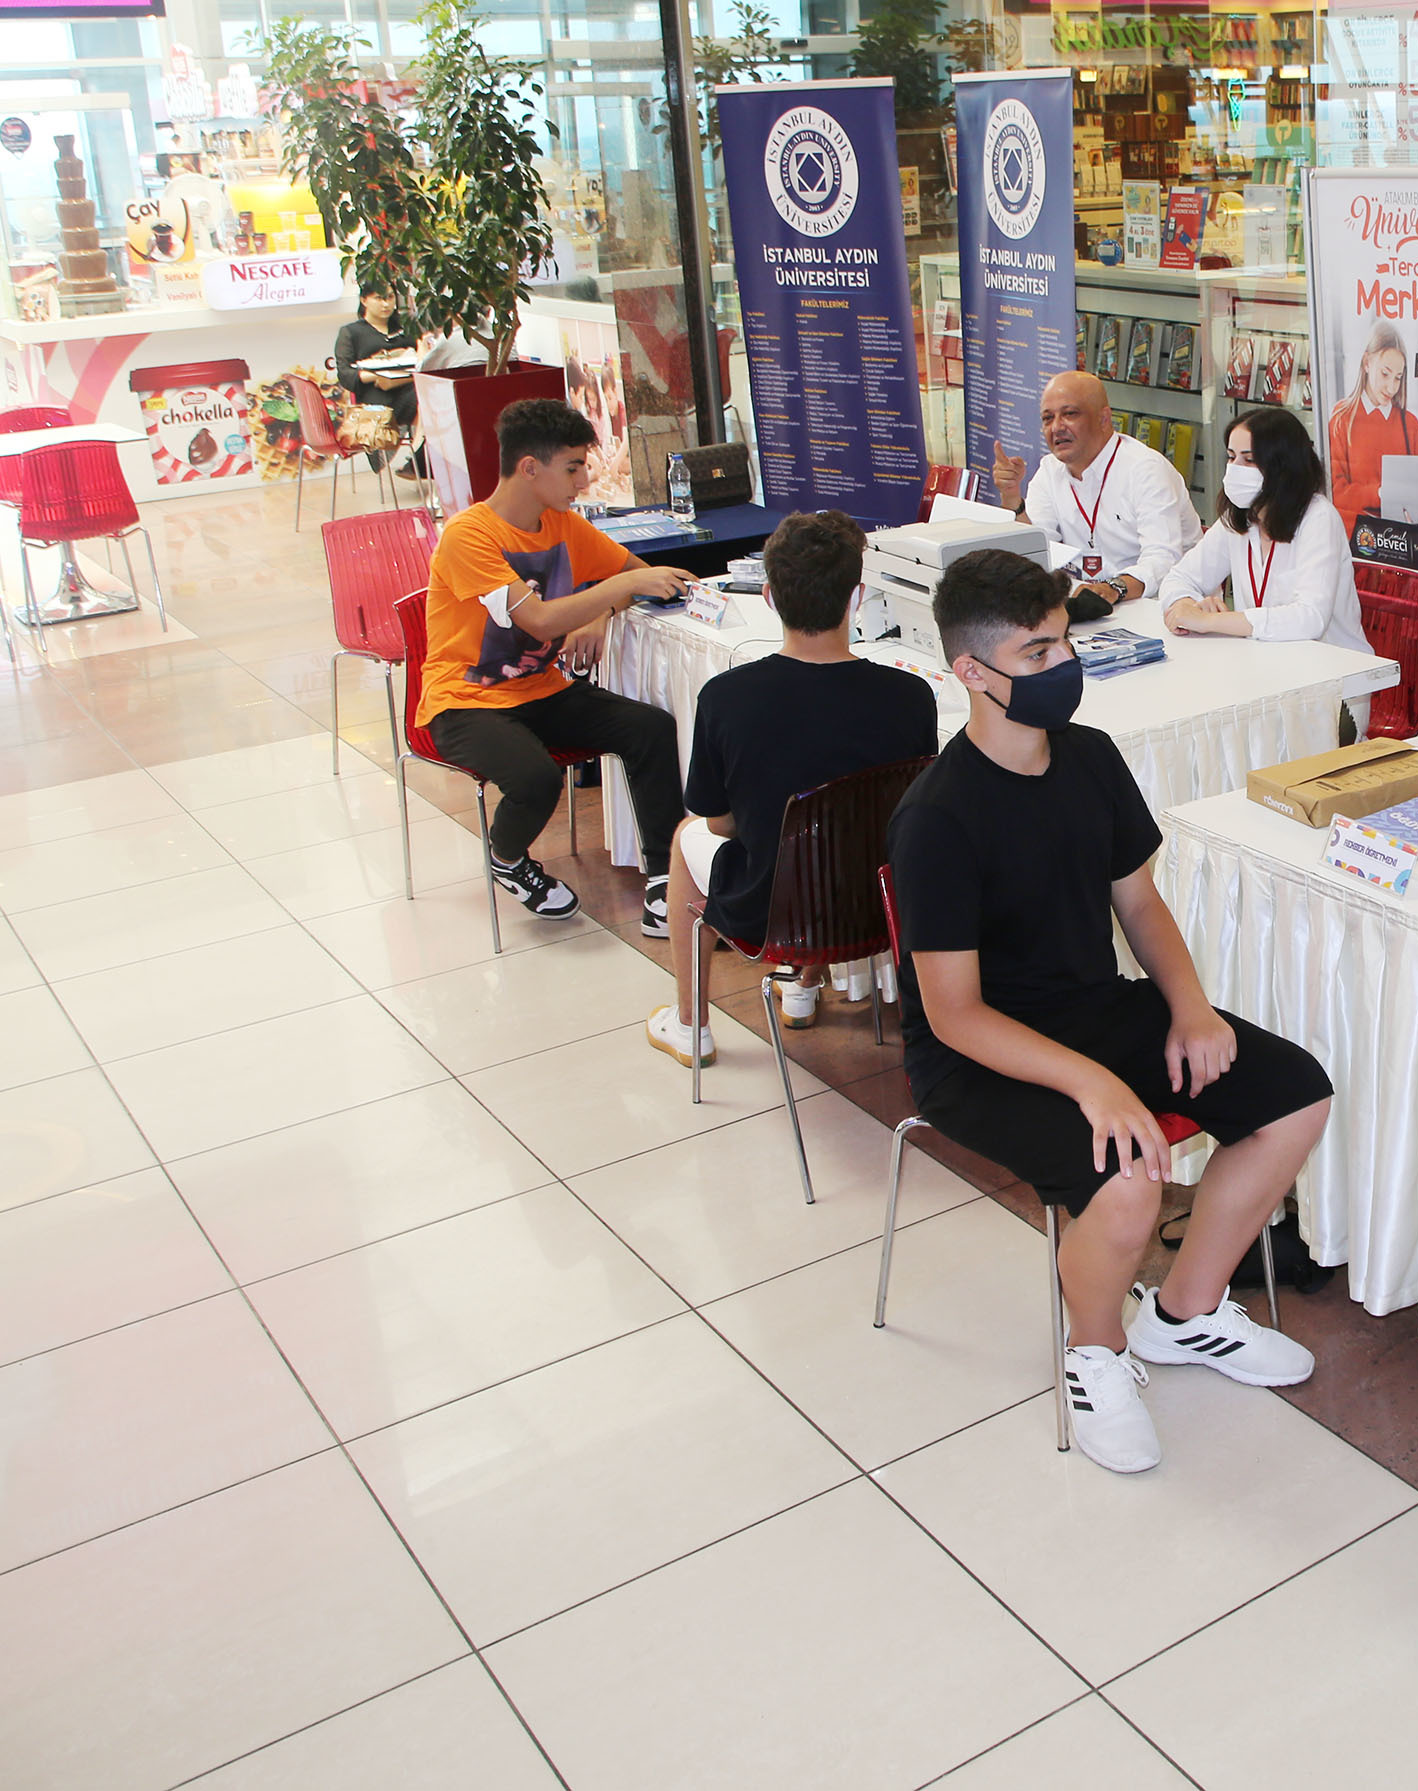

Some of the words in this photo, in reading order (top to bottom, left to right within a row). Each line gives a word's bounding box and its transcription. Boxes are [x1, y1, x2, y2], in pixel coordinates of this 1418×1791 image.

[1384, 192, 1413, 204] ATAKUM
[126, 199, 161, 223] Çay
[762, 244, 831, 264] İSTANBUL
[835, 248, 878, 264] AYDIN
[979, 243, 1023, 268] İSTANBUL
[1025, 253, 1056, 272] AYDIN
[230, 256, 314, 282] NESCAFÉ
[775, 267, 870, 287] ÜNİVERSİTESİ
[242, 282, 306, 304] Alegria
[984, 269, 1049, 296] ÜNİVERSİTESİ
[161, 407, 233, 425] chokella
[1377, 538, 1407, 553] DEVECİ
